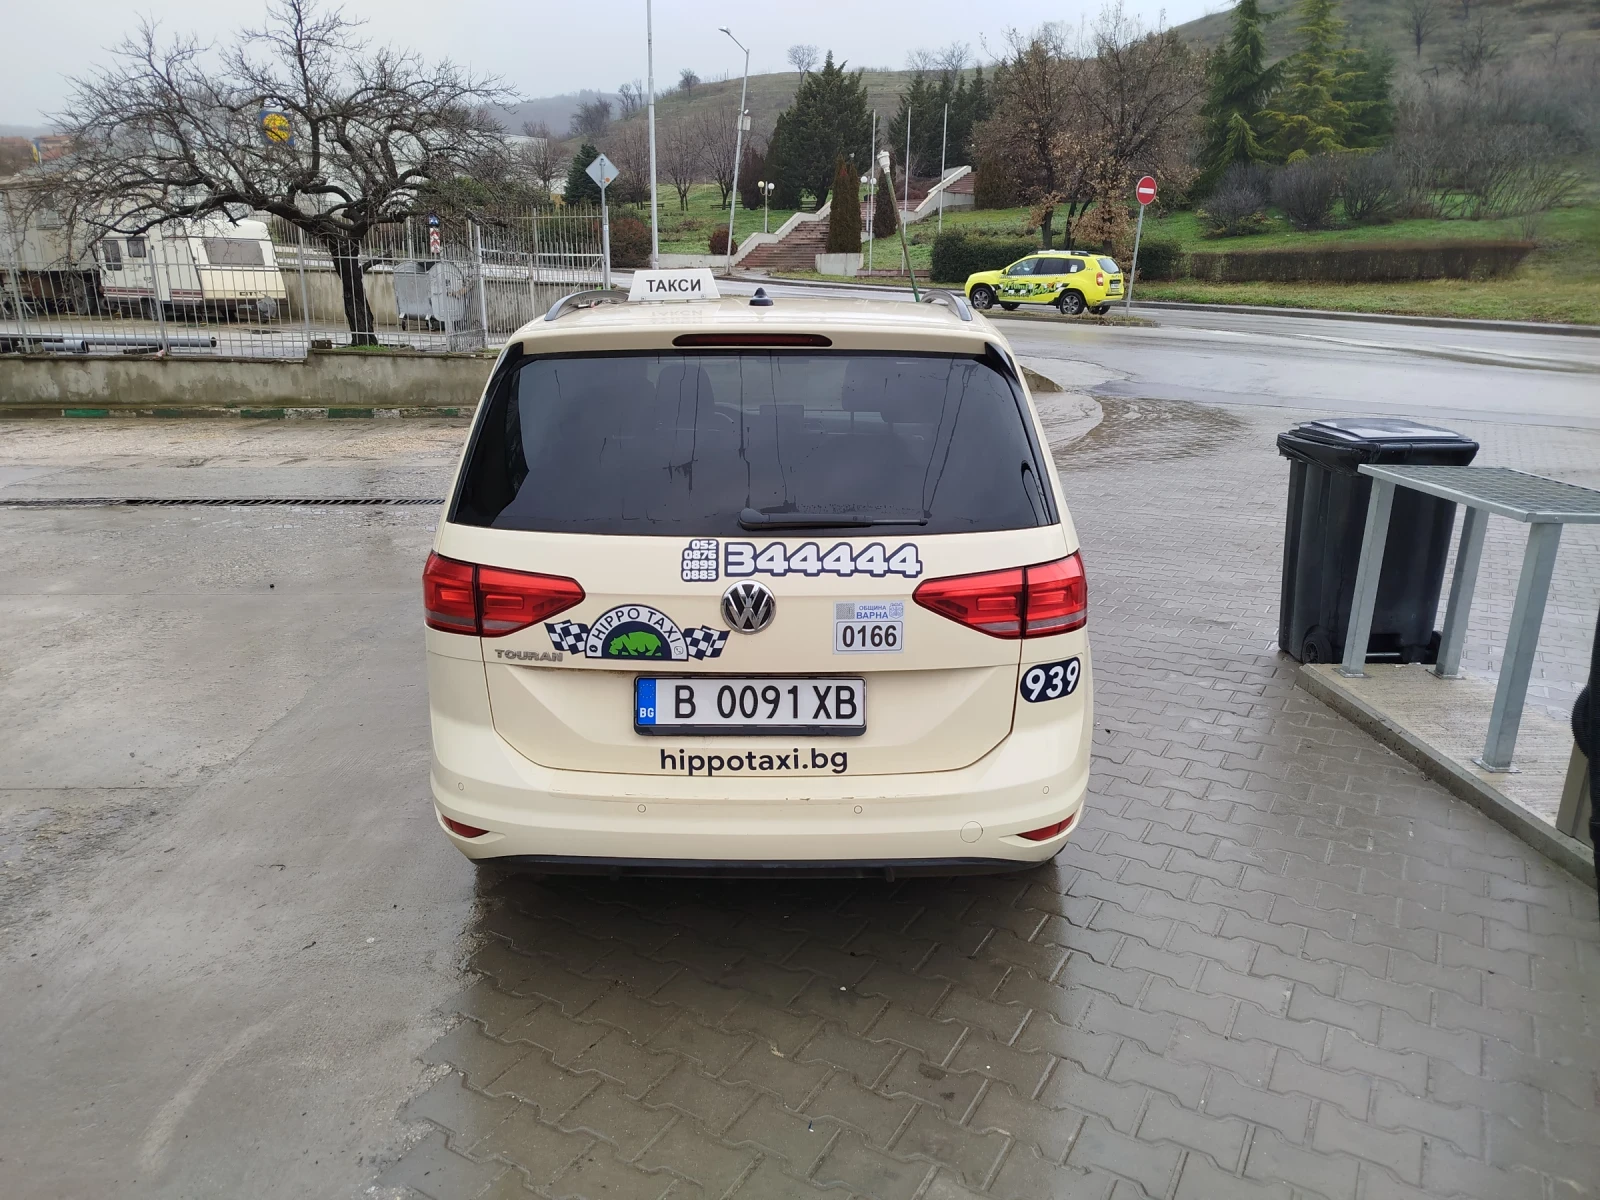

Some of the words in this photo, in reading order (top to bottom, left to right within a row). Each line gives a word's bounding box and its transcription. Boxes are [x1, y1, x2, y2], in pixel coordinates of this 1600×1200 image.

[646, 279, 701, 292] ТАКСИ
[691, 540, 717, 549] 052
[684, 550, 717, 559] 0876
[727, 542, 922, 577] 344444
[683, 560, 717, 569] 0899
[682, 570, 717, 580] 0883
[858, 604, 887, 612] ОБЩИНА
[856, 610, 889, 620] ВАРНА
[593, 607, 641, 641] HIPPO
[647, 610, 681, 643] TAXI
[842, 625, 897, 647] 0166
[494, 648, 564, 662] TOURAN
[1024, 659, 1080, 702] 939
[674, 685, 696, 719] B
[717, 685, 798, 719] 0091
[812, 685, 857, 720] XB
[639, 707, 655, 718] BG
[660, 748, 848, 776] hippotaxi.bg
